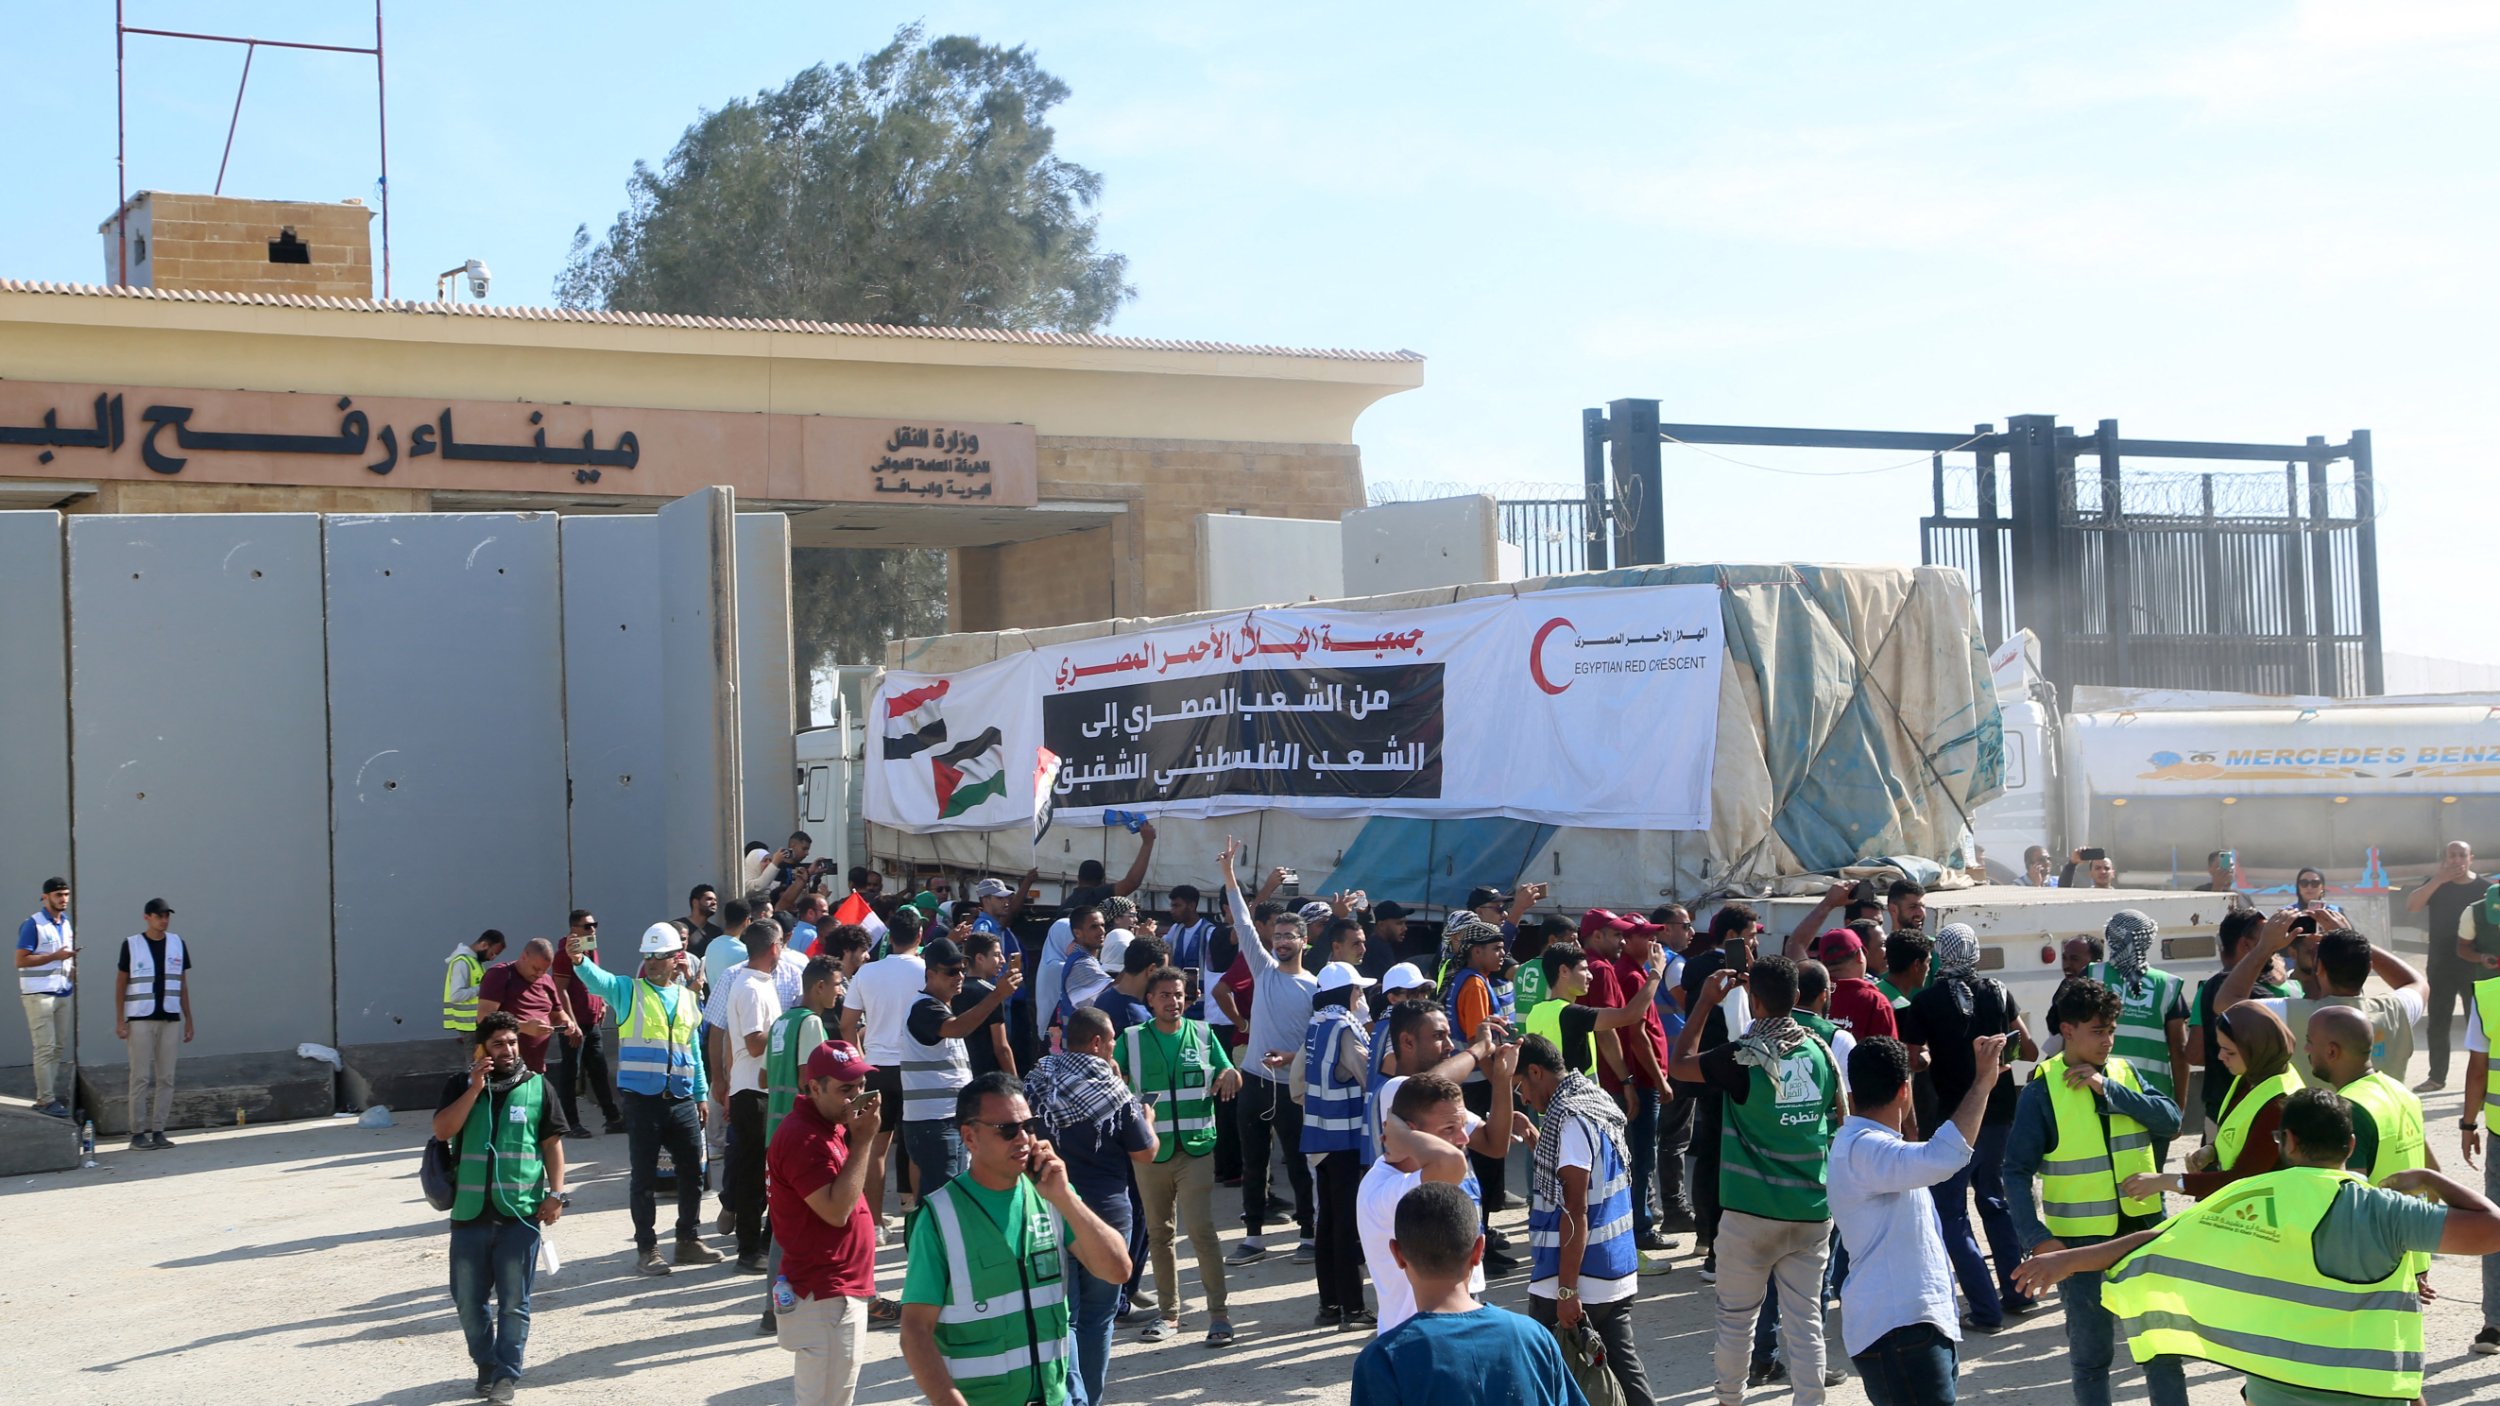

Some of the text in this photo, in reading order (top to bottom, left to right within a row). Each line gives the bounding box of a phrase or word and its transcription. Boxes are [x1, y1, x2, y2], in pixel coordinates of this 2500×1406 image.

[0, 392, 640, 484] ميناء رفح الب
[887, 426, 979, 455] وزارة النقل
[1625, 626, 1672, 647] الأحمر
[1673, 626, 1709, 645] الهلال
[1055, 623, 1425, 691] جمعية الهلال الأحمر المصري
[1574, 656, 1707, 675] EGYPTIAN RED CRESCENT
[1081, 677, 1391, 742] من الشعب المصري إلى
[1053, 734, 1425, 795] الشعب الفلسطيني الشقيق
[2225, 746, 2406, 767] MERCEDES
[1780, 1111, 1819, 1125] متطوع
